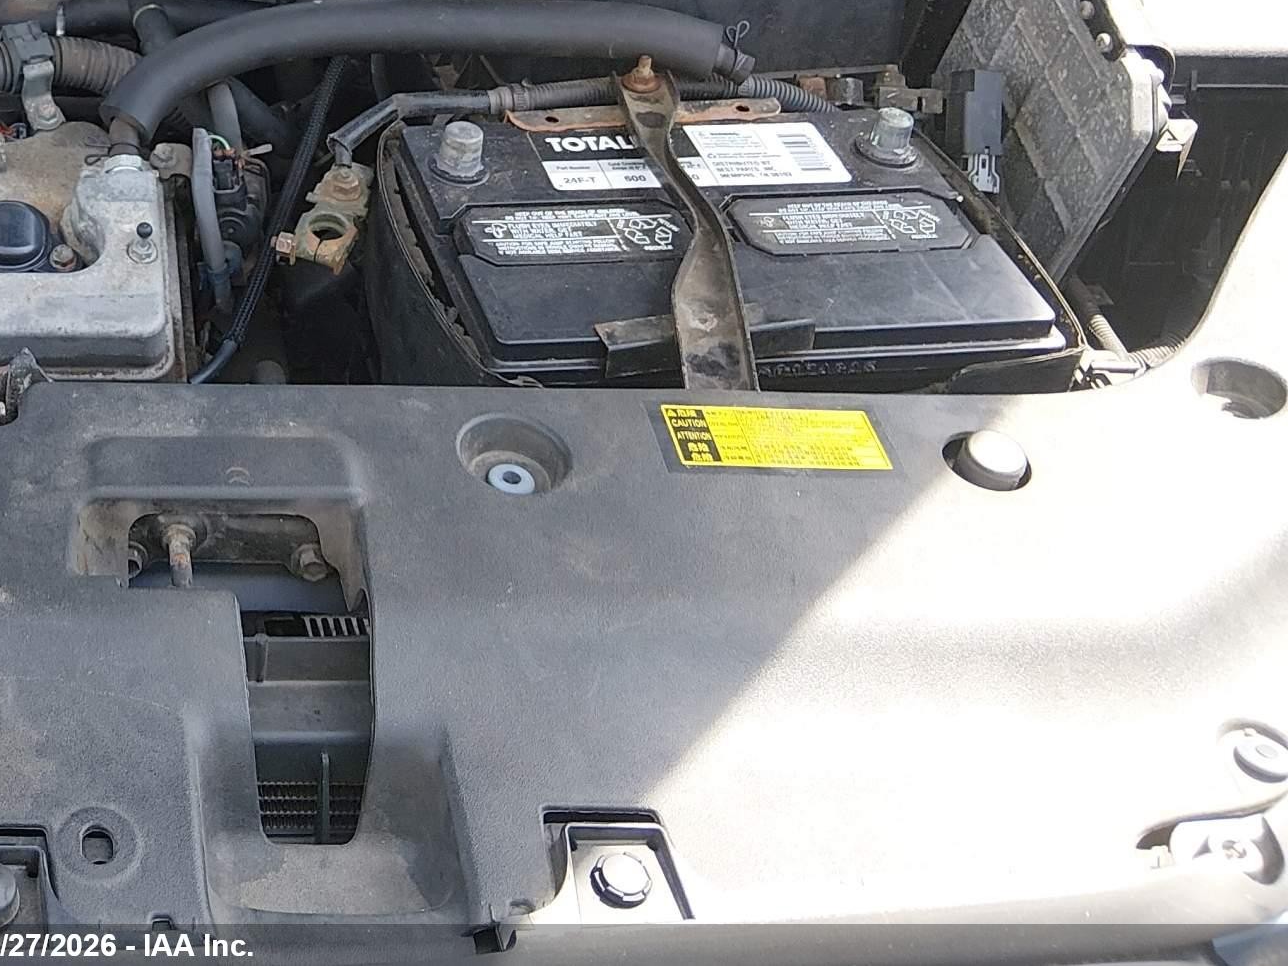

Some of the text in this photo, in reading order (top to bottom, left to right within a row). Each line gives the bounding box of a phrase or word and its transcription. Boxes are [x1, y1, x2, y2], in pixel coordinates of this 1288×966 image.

[545, 135, 635, 152] TOTAL
[672, 418, 707, 427] CAUTION
[677, 431, 712, 440] ATTENTION
